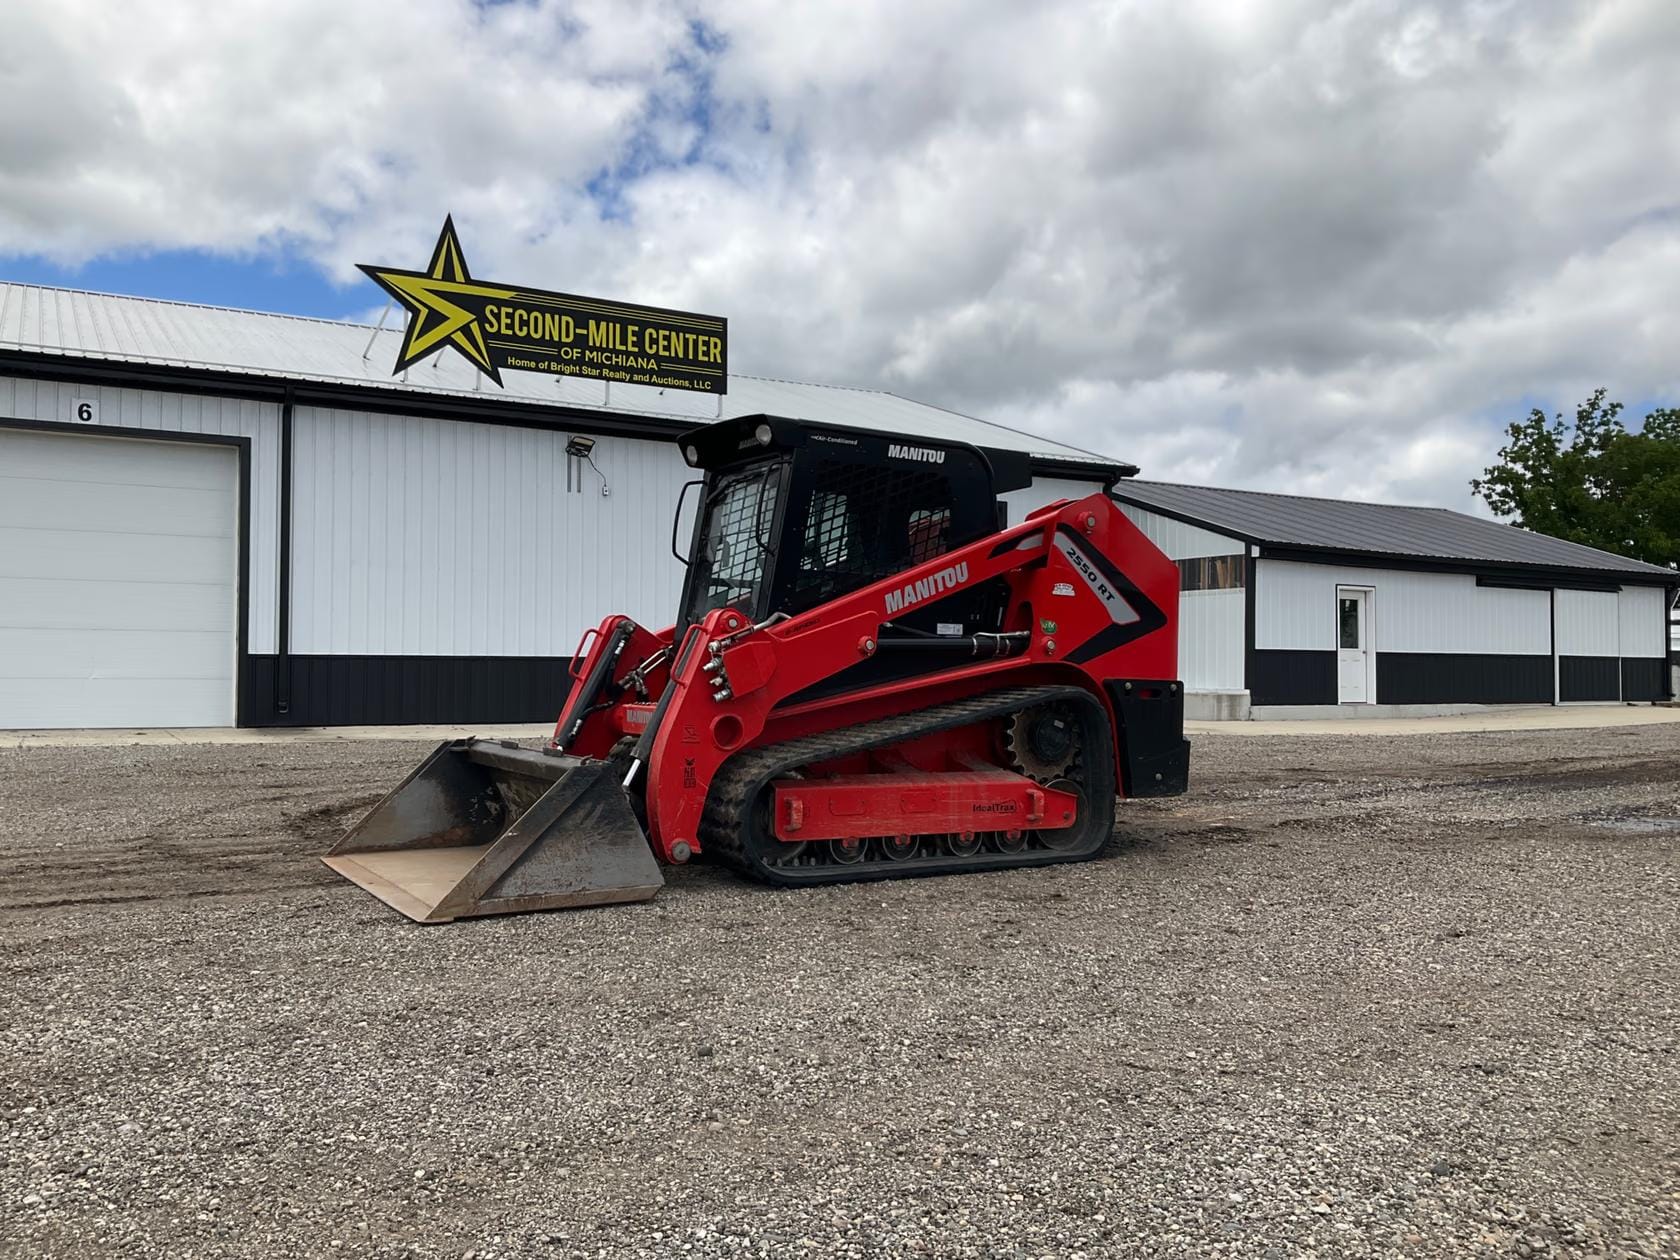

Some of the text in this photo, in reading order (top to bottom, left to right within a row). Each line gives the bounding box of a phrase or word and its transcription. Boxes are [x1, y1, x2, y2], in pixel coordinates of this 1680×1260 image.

[484, 304, 722, 363] SECOND-MILE CENTER
[507, 356, 712, 390] Home of Bright Star Realty and Auctions, LLC
[560, 347, 658, 371] OF MICHIANA
[78, 403, 92, 421] 6
[888, 444, 946, 464] MANITOU
[884, 561, 969, 615] MANITOU
[1066, 547, 1115, 600] 2550 RT
